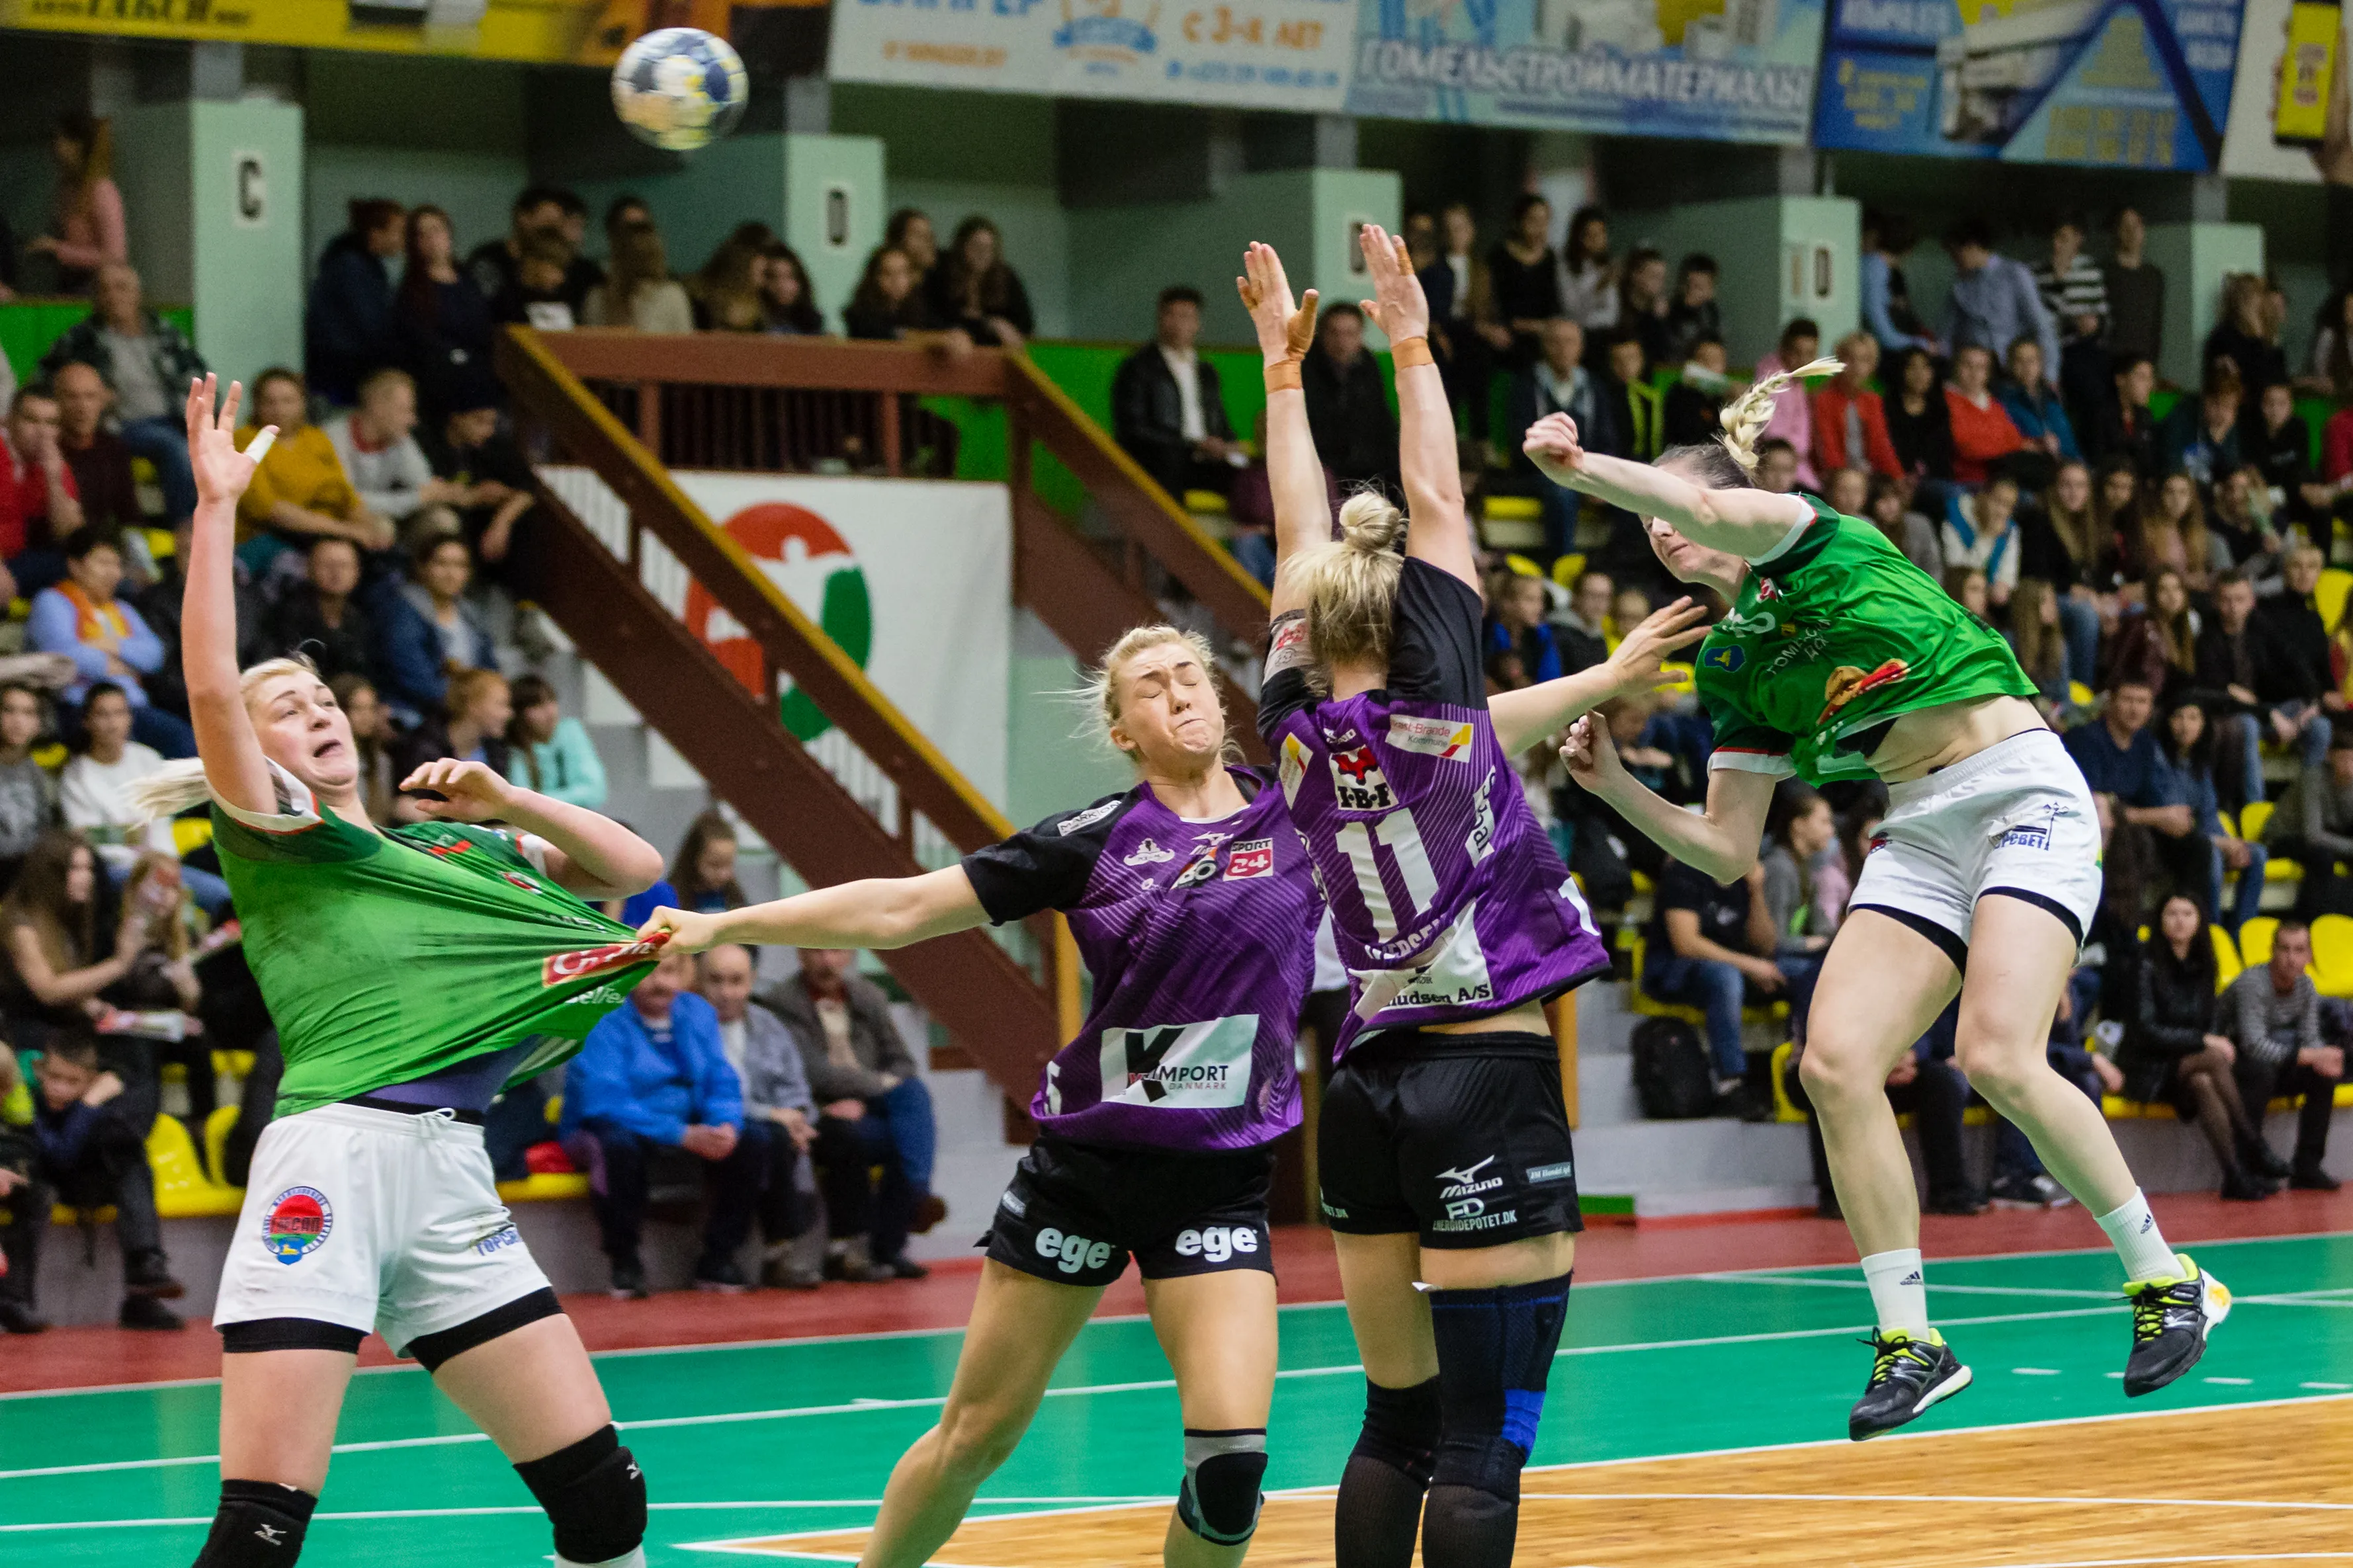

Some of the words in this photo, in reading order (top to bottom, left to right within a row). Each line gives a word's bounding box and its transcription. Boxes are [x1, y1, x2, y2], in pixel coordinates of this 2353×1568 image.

[1359, 40, 1806, 107] ГОМЕЛЬСТРОЙМАТЕРИАЛЫ
[1231, 839, 1271, 852] SPORT
[1230, 854, 1269, 874] 24
[1336, 807, 1439, 944] 11
[1457, 983, 1490, 1003] A/S
[1169, 1082, 1227, 1091] DANMARK
[1035, 1227, 1111, 1274] ege
[1175, 1226, 1258, 1263] ege
